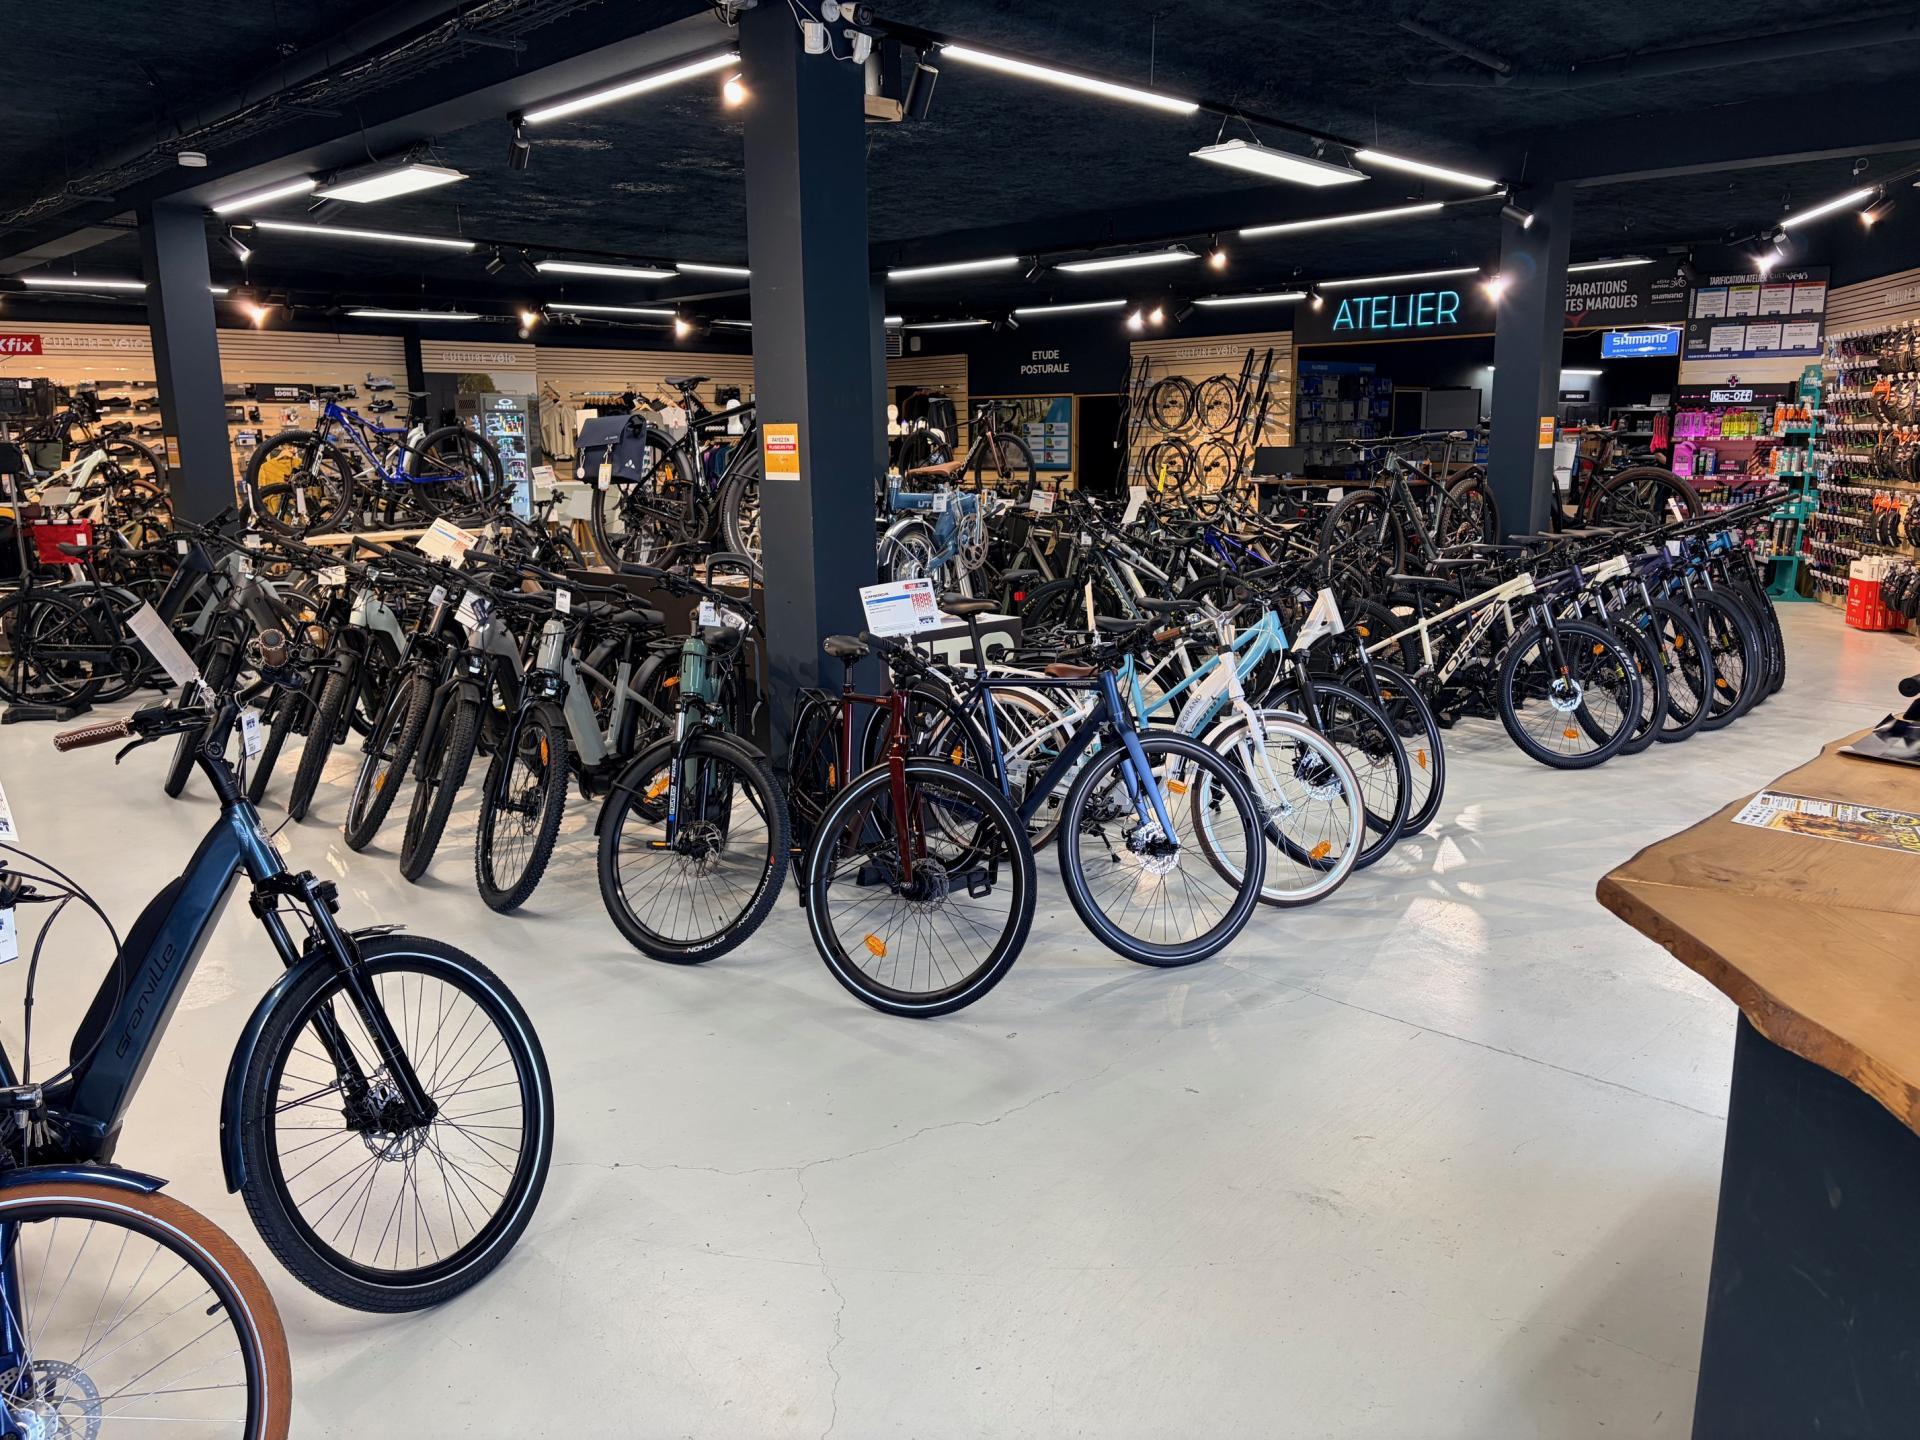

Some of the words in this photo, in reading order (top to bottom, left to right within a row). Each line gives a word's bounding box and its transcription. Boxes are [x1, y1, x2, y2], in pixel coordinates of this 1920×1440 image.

[1586, 294, 1638, 311] MARQUES
[1651, 292, 1683, 300] SHIMANO
[1333, 290, 1460, 331] ATELIER
[43, 336, 102, 350] CULTURE
[1612, 334, 1668, 346] SHIMANO
[442, 351, 488, 364] CULTURE
[1032, 350, 1060, 361] ETUDE
[1176, 346, 1212, 359] CULTURE
[1020, 363, 1070, 375] POSTURALE
[1712, 391, 1751, 401] Muc-Off
[1445, 600, 1505, 675] ORBEA
[1614, 645, 1637, 681] KENDA
[738, 865, 773, 926] HUTCHINSON
[687, 934, 726, 953] PYTHON
